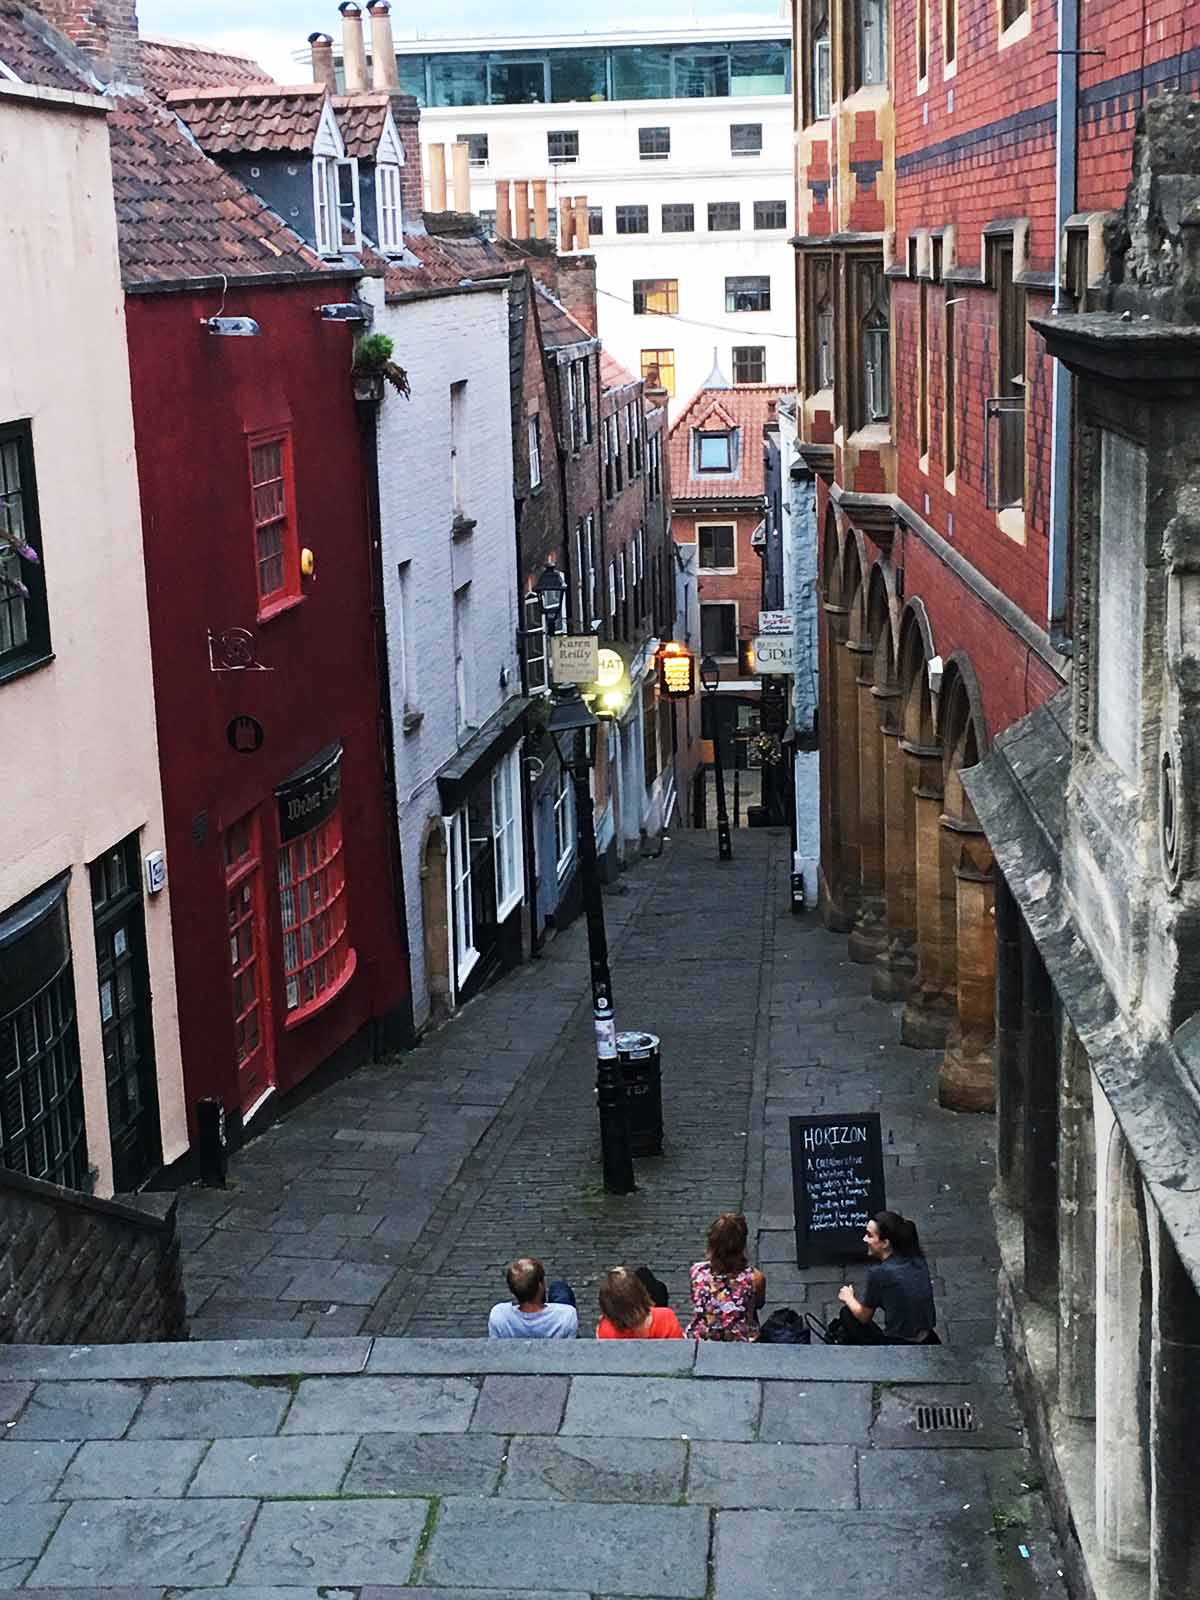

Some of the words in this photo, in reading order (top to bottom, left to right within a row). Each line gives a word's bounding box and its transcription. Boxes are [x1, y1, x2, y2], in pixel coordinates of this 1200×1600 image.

[559, 638, 591, 649] Karen
[559, 648, 592, 661] Reilly
[804, 1125, 867, 1152] HORIZON
